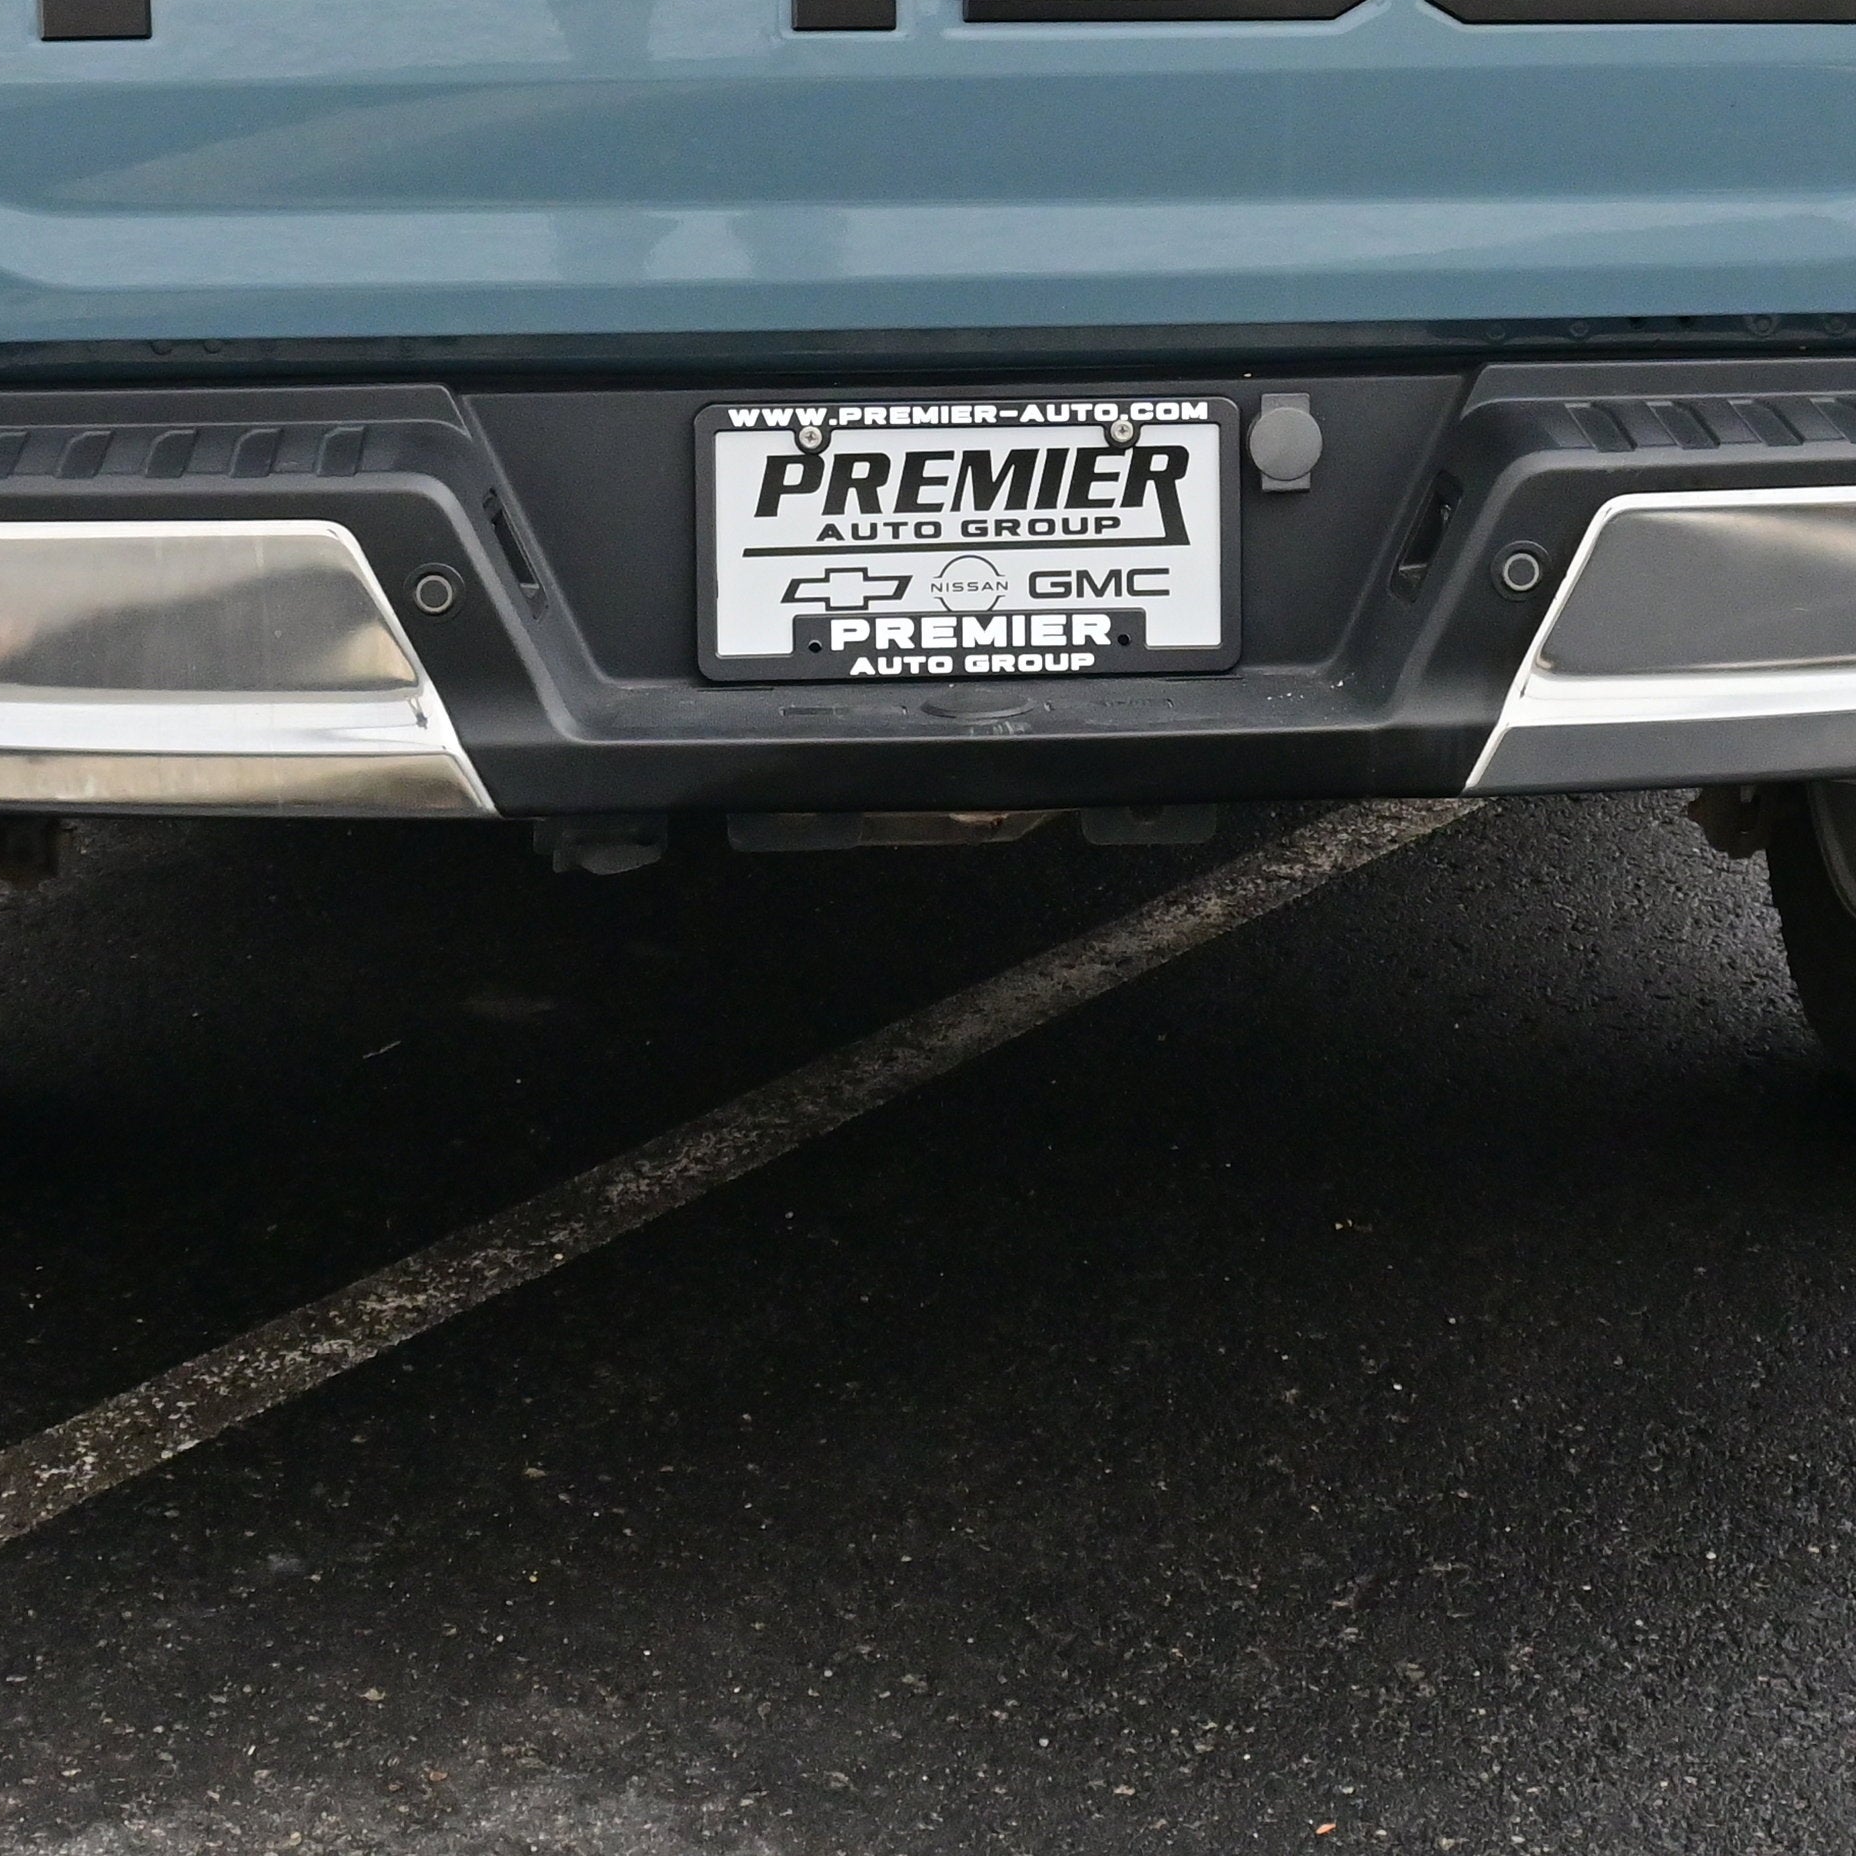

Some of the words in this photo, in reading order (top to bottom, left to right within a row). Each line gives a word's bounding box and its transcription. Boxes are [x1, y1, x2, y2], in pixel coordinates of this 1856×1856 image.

[728, 401, 1210, 428] WWW.PREMIER-AUTO.COM
[754, 445, 1190, 520] PREMIER
[815, 521, 943, 542] AUTO
[959, 515, 1123, 539] GROUP
[929, 577, 1010, 594] NISSAN
[1027, 567, 1171, 600] GMC
[830, 613, 1113, 652] PREMIER
[848, 653, 957, 677] AUTO
[963, 652, 1097, 674] GROUP
